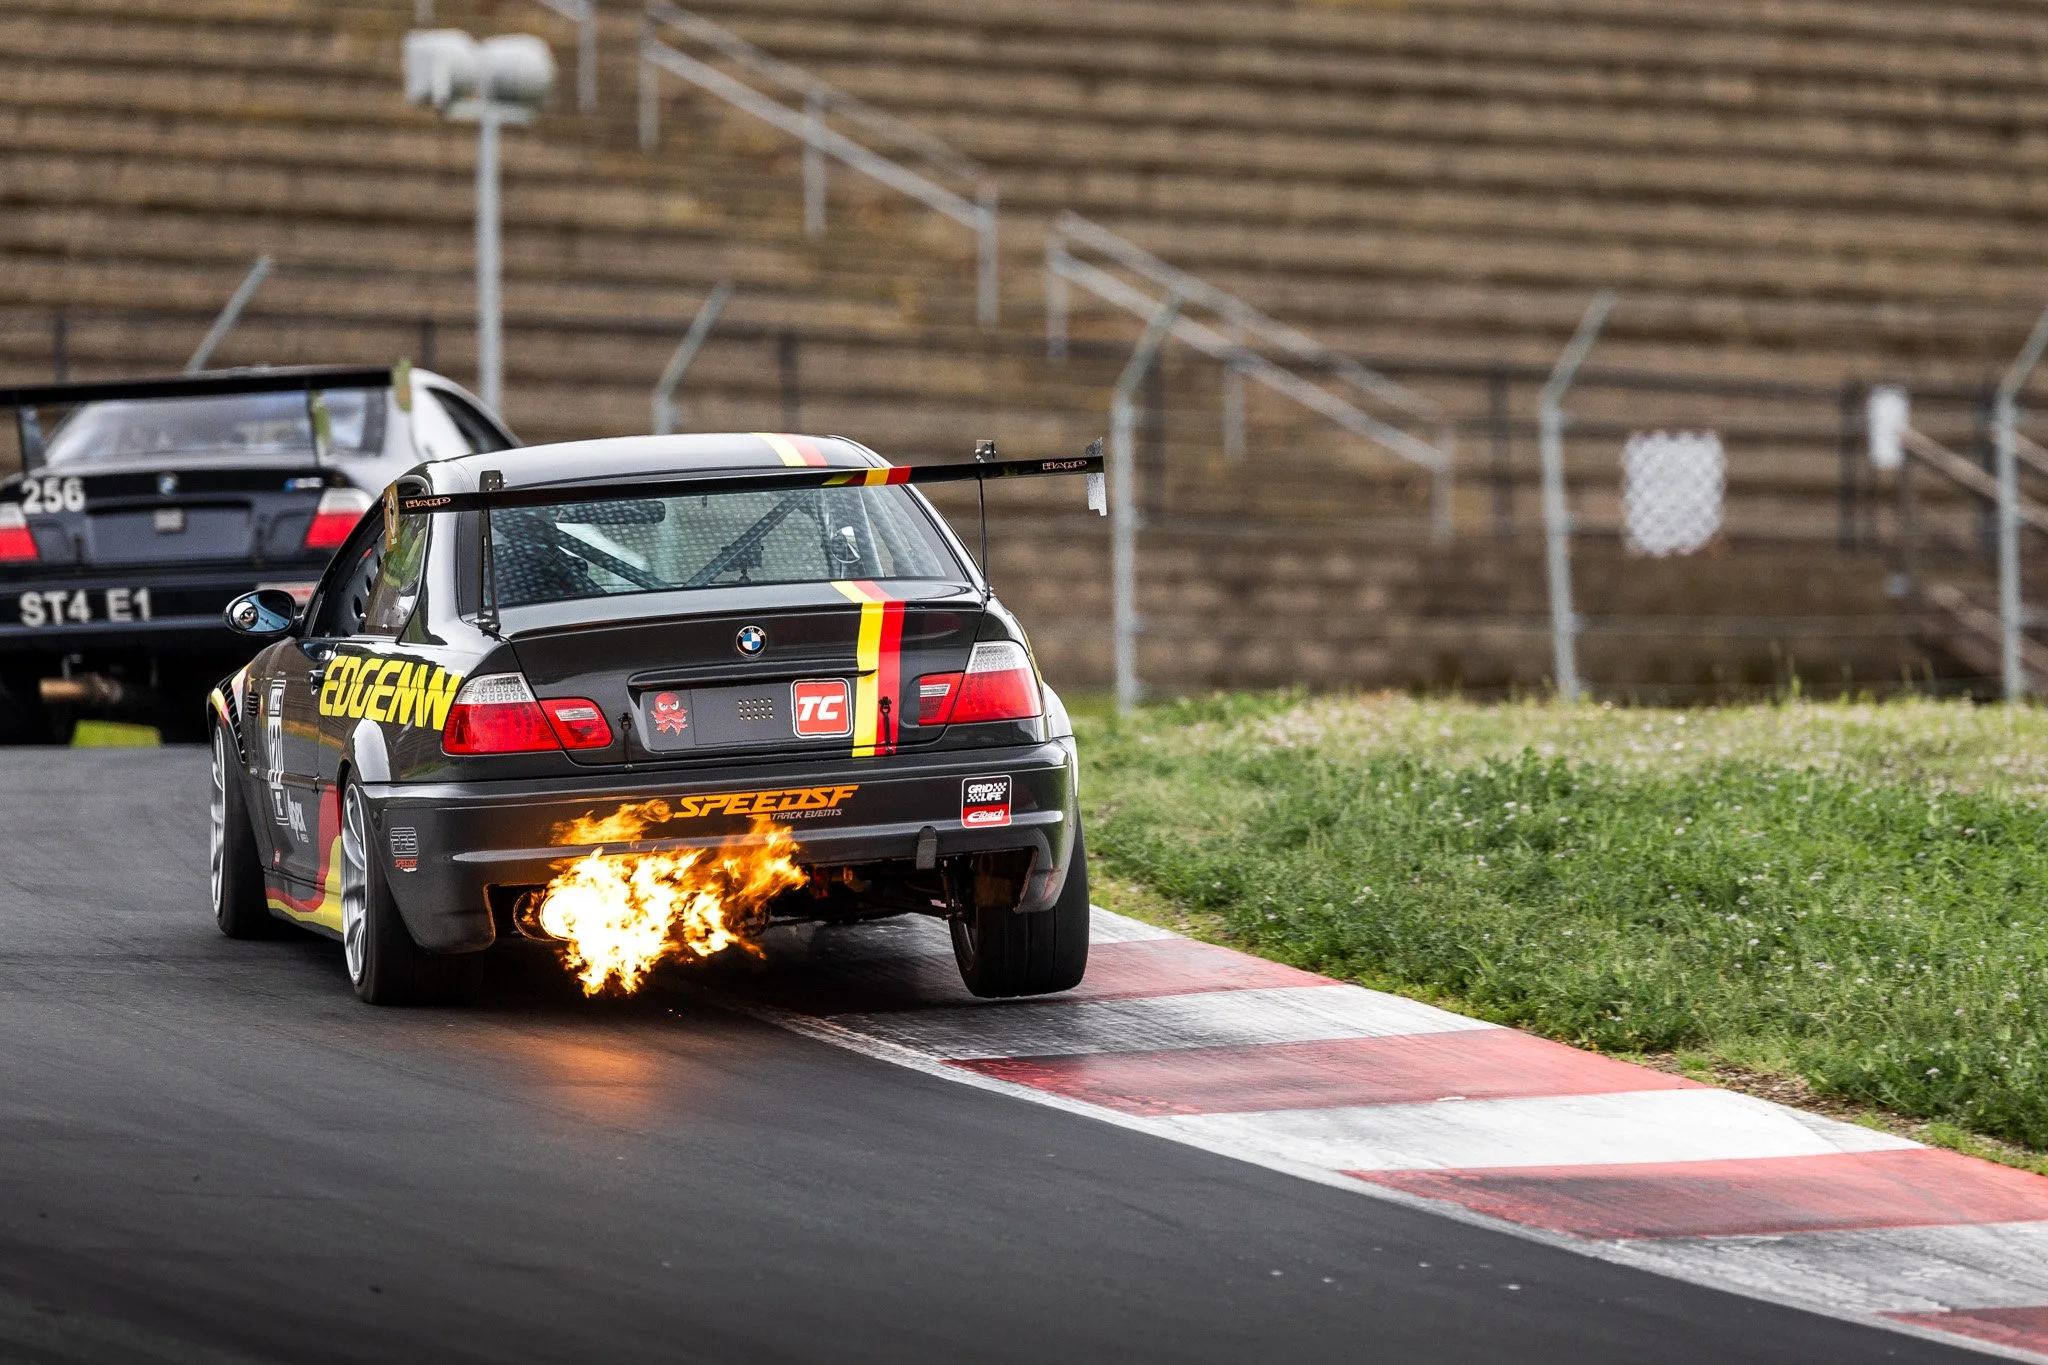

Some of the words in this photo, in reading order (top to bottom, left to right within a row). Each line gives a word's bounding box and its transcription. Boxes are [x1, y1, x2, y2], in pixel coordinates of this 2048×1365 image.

[21, 478, 85, 515] 256
[20, 589, 90, 627] ST4
[107, 587, 151, 622] E1
[798, 695, 844, 722] TC
[673, 785, 859, 819] SPEEDSF
[968, 783, 994, 794] GRID
[981, 791, 1004, 801] LIFE
[771, 811, 803, 821] TRACK
[805, 808, 843, 819] EVENTS
